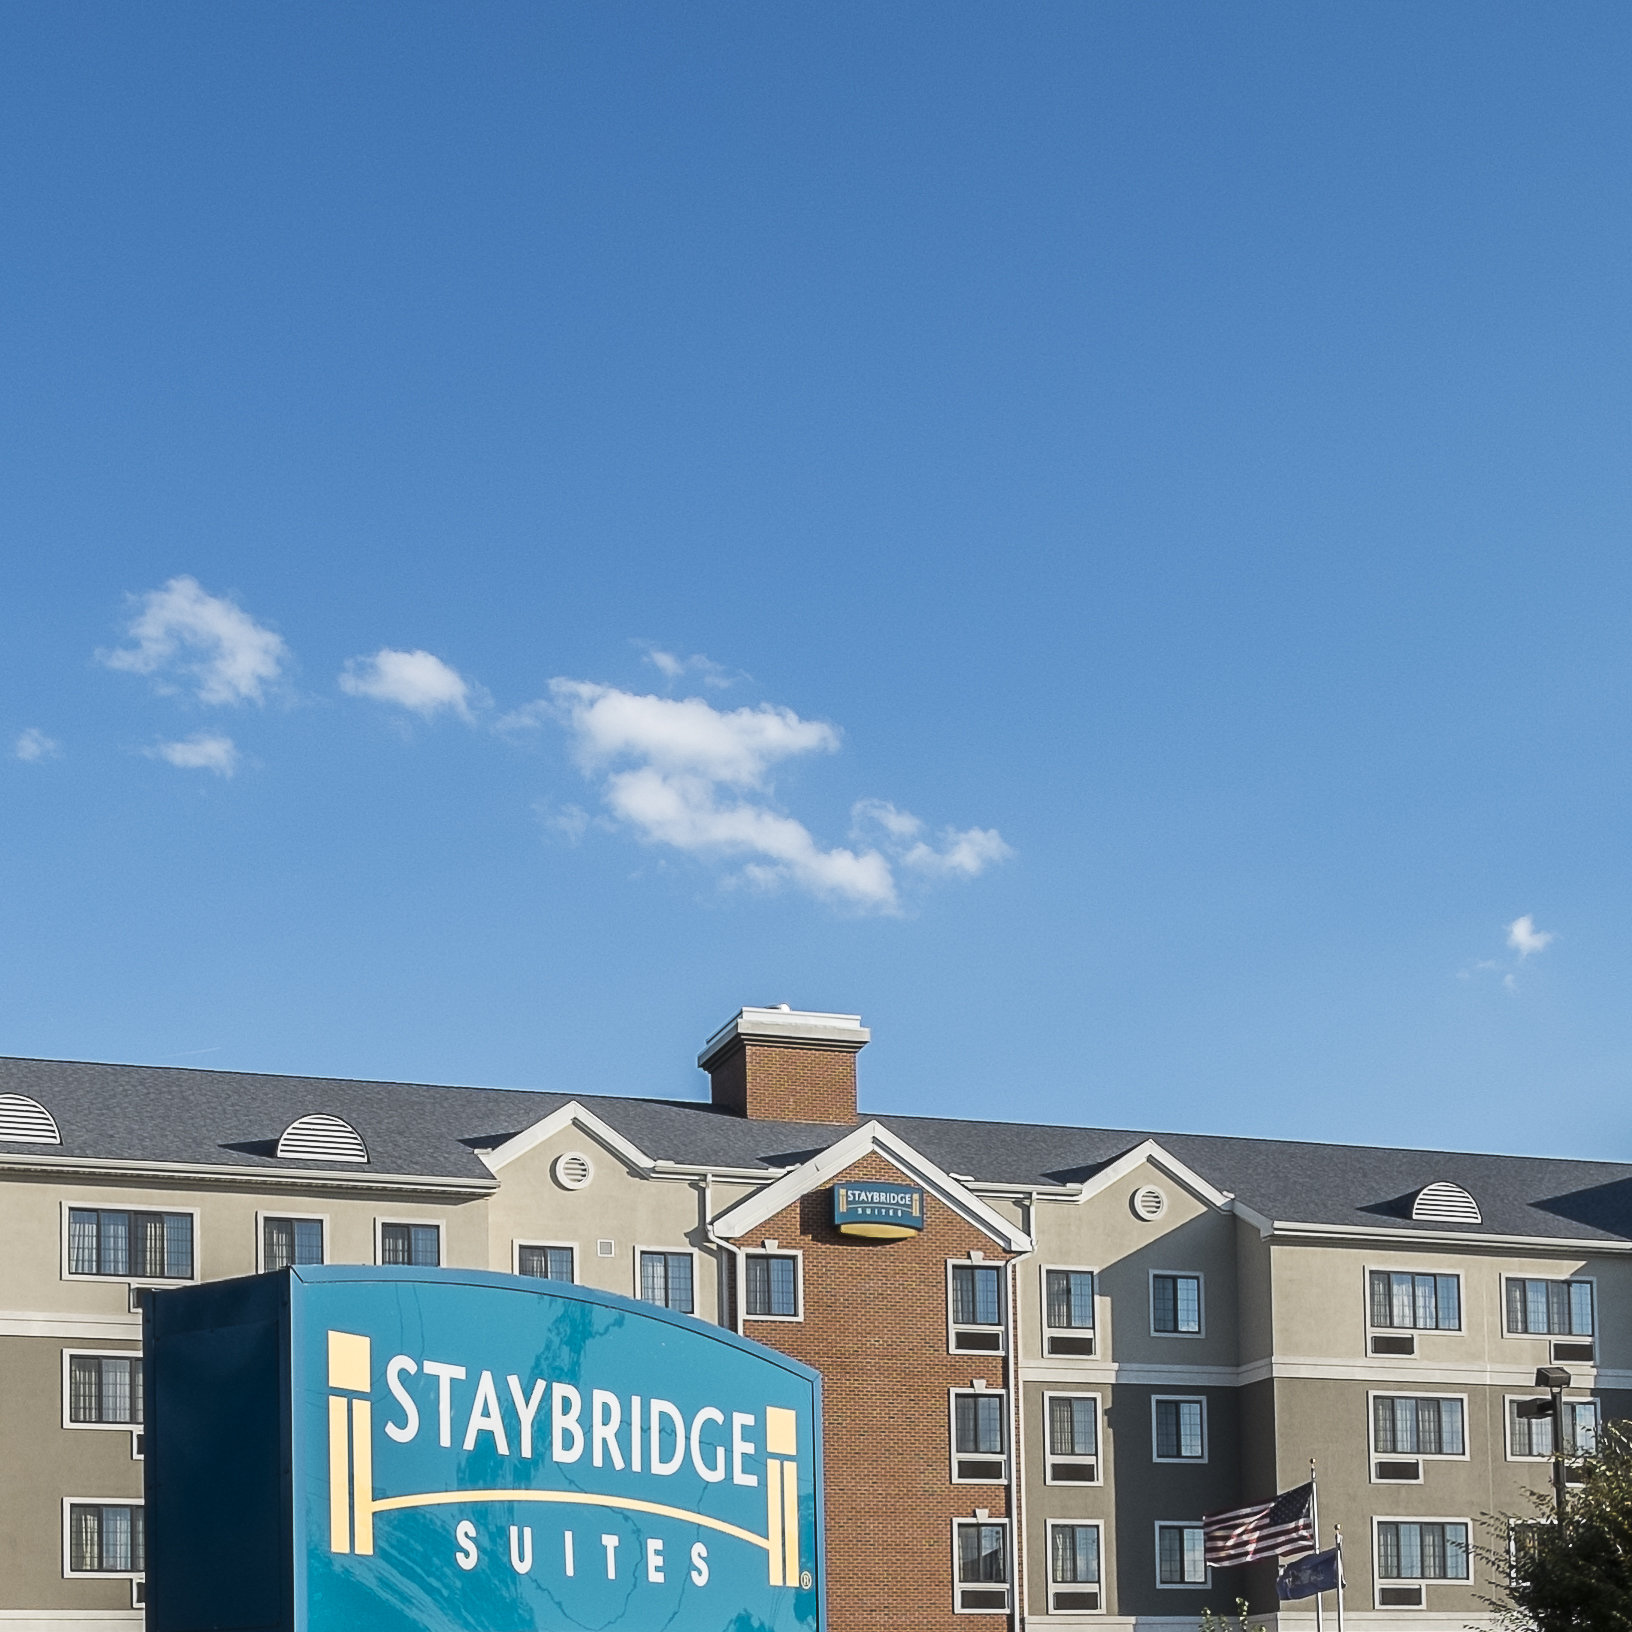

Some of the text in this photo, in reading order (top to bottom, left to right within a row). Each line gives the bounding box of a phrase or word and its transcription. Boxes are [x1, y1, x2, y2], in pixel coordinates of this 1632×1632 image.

[847, 1190, 912, 1205] STAYBRIDGE
[384, 1353, 759, 1487] STAYBRIDGE
[455, 1519, 710, 1587] SUITES
